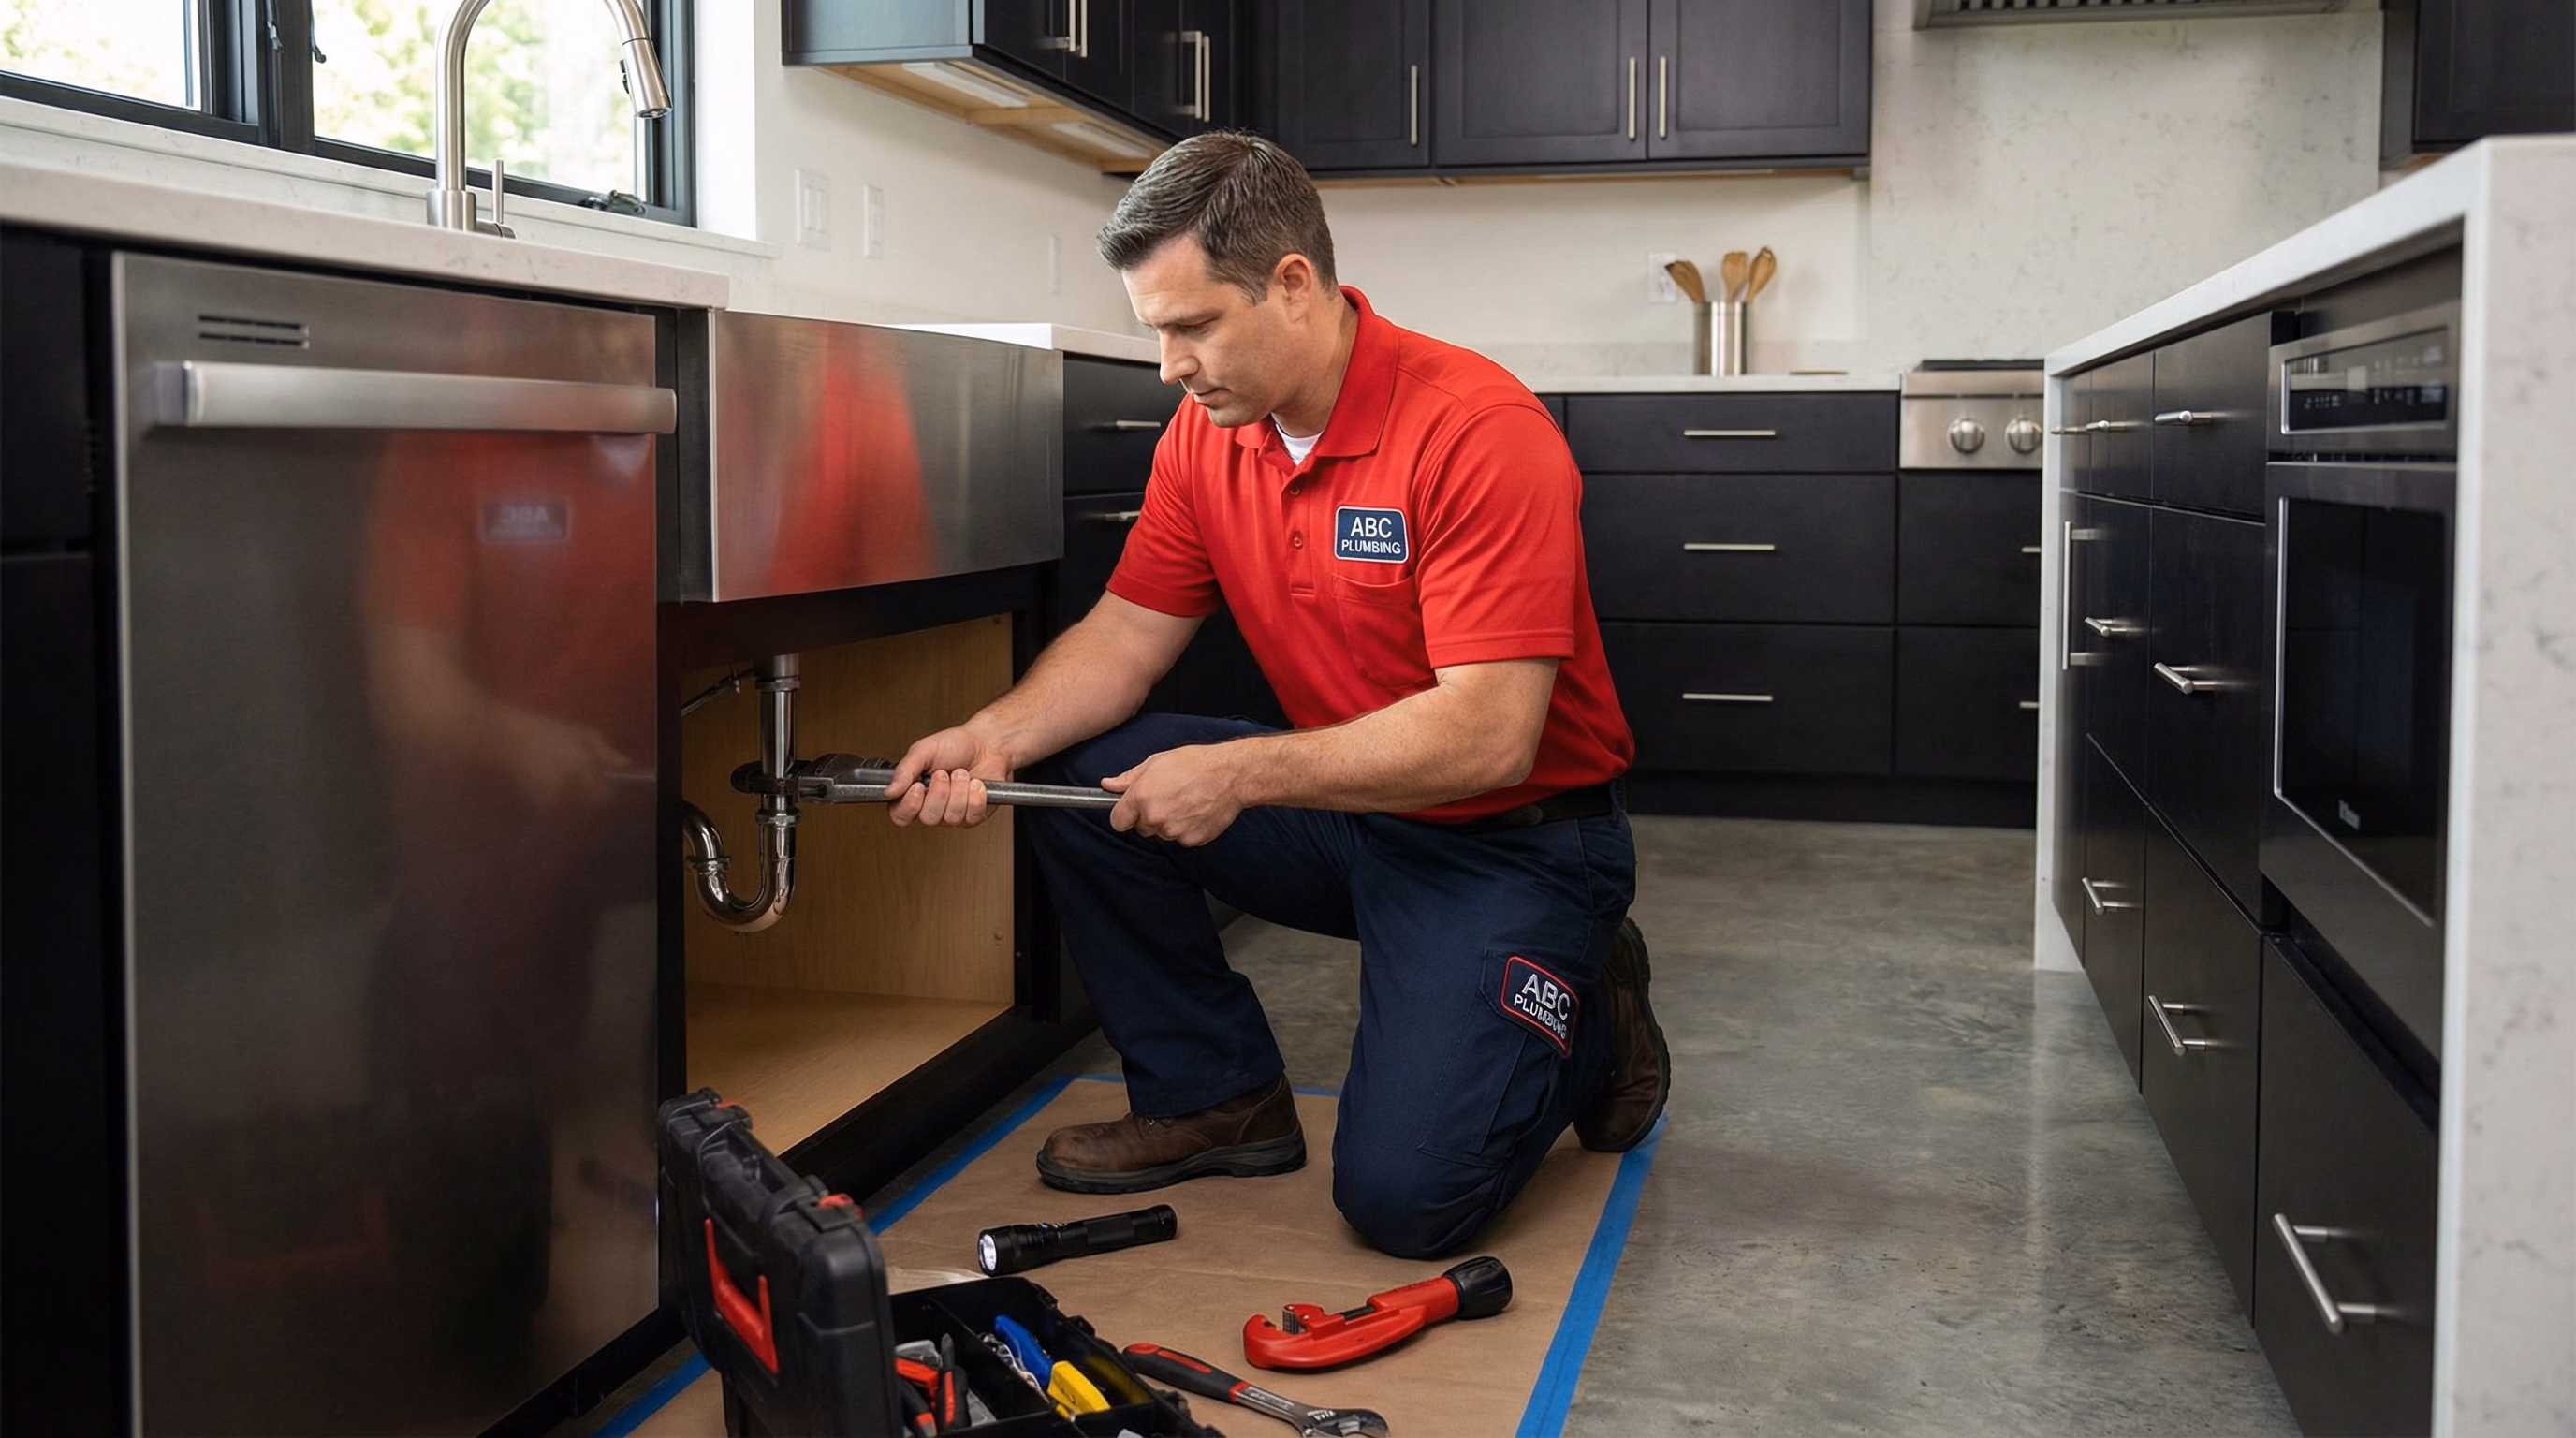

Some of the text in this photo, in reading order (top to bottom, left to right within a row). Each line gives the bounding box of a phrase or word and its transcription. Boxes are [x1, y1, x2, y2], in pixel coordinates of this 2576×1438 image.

[1350, 516, 1392, 538] ABC
[1341, 539, 1401, 554] PLUMBING
[1521, 973, 1570, 1020] ABC
